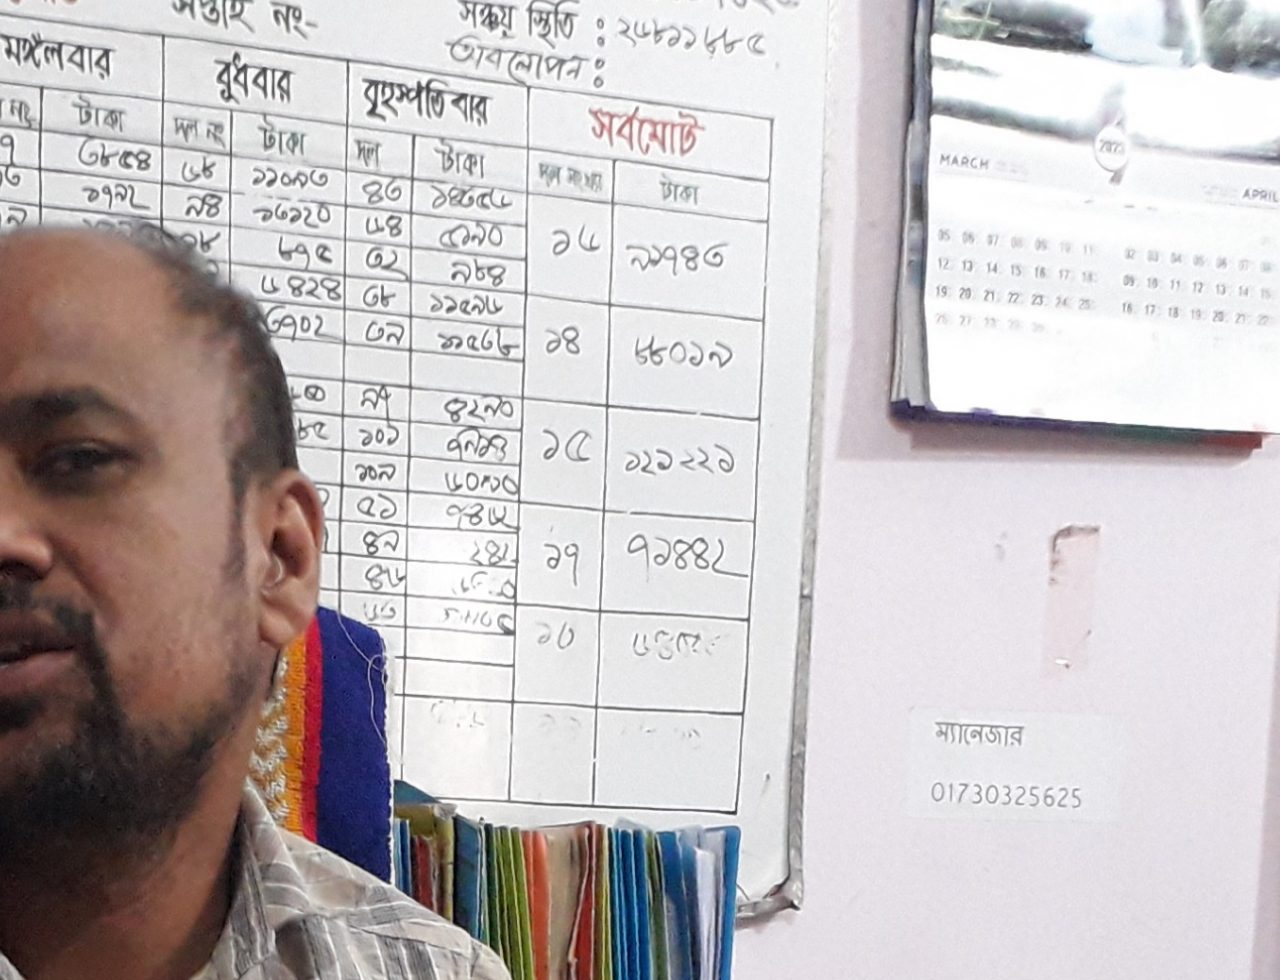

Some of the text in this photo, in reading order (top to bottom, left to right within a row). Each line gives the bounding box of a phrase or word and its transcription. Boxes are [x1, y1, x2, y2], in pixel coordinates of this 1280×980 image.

[71, 94, 127, 132] টাকা
[256, 113, 309, 156] টাকা
[433, 138, 486, 179] টাকা
[938, 153, 991, 171] MARCH
[1241, 186, 1280, 204] APRIL
[934, 721, 1026, 748] ম্যানেজার
[931, 782, 1083, 809] 01730325625
